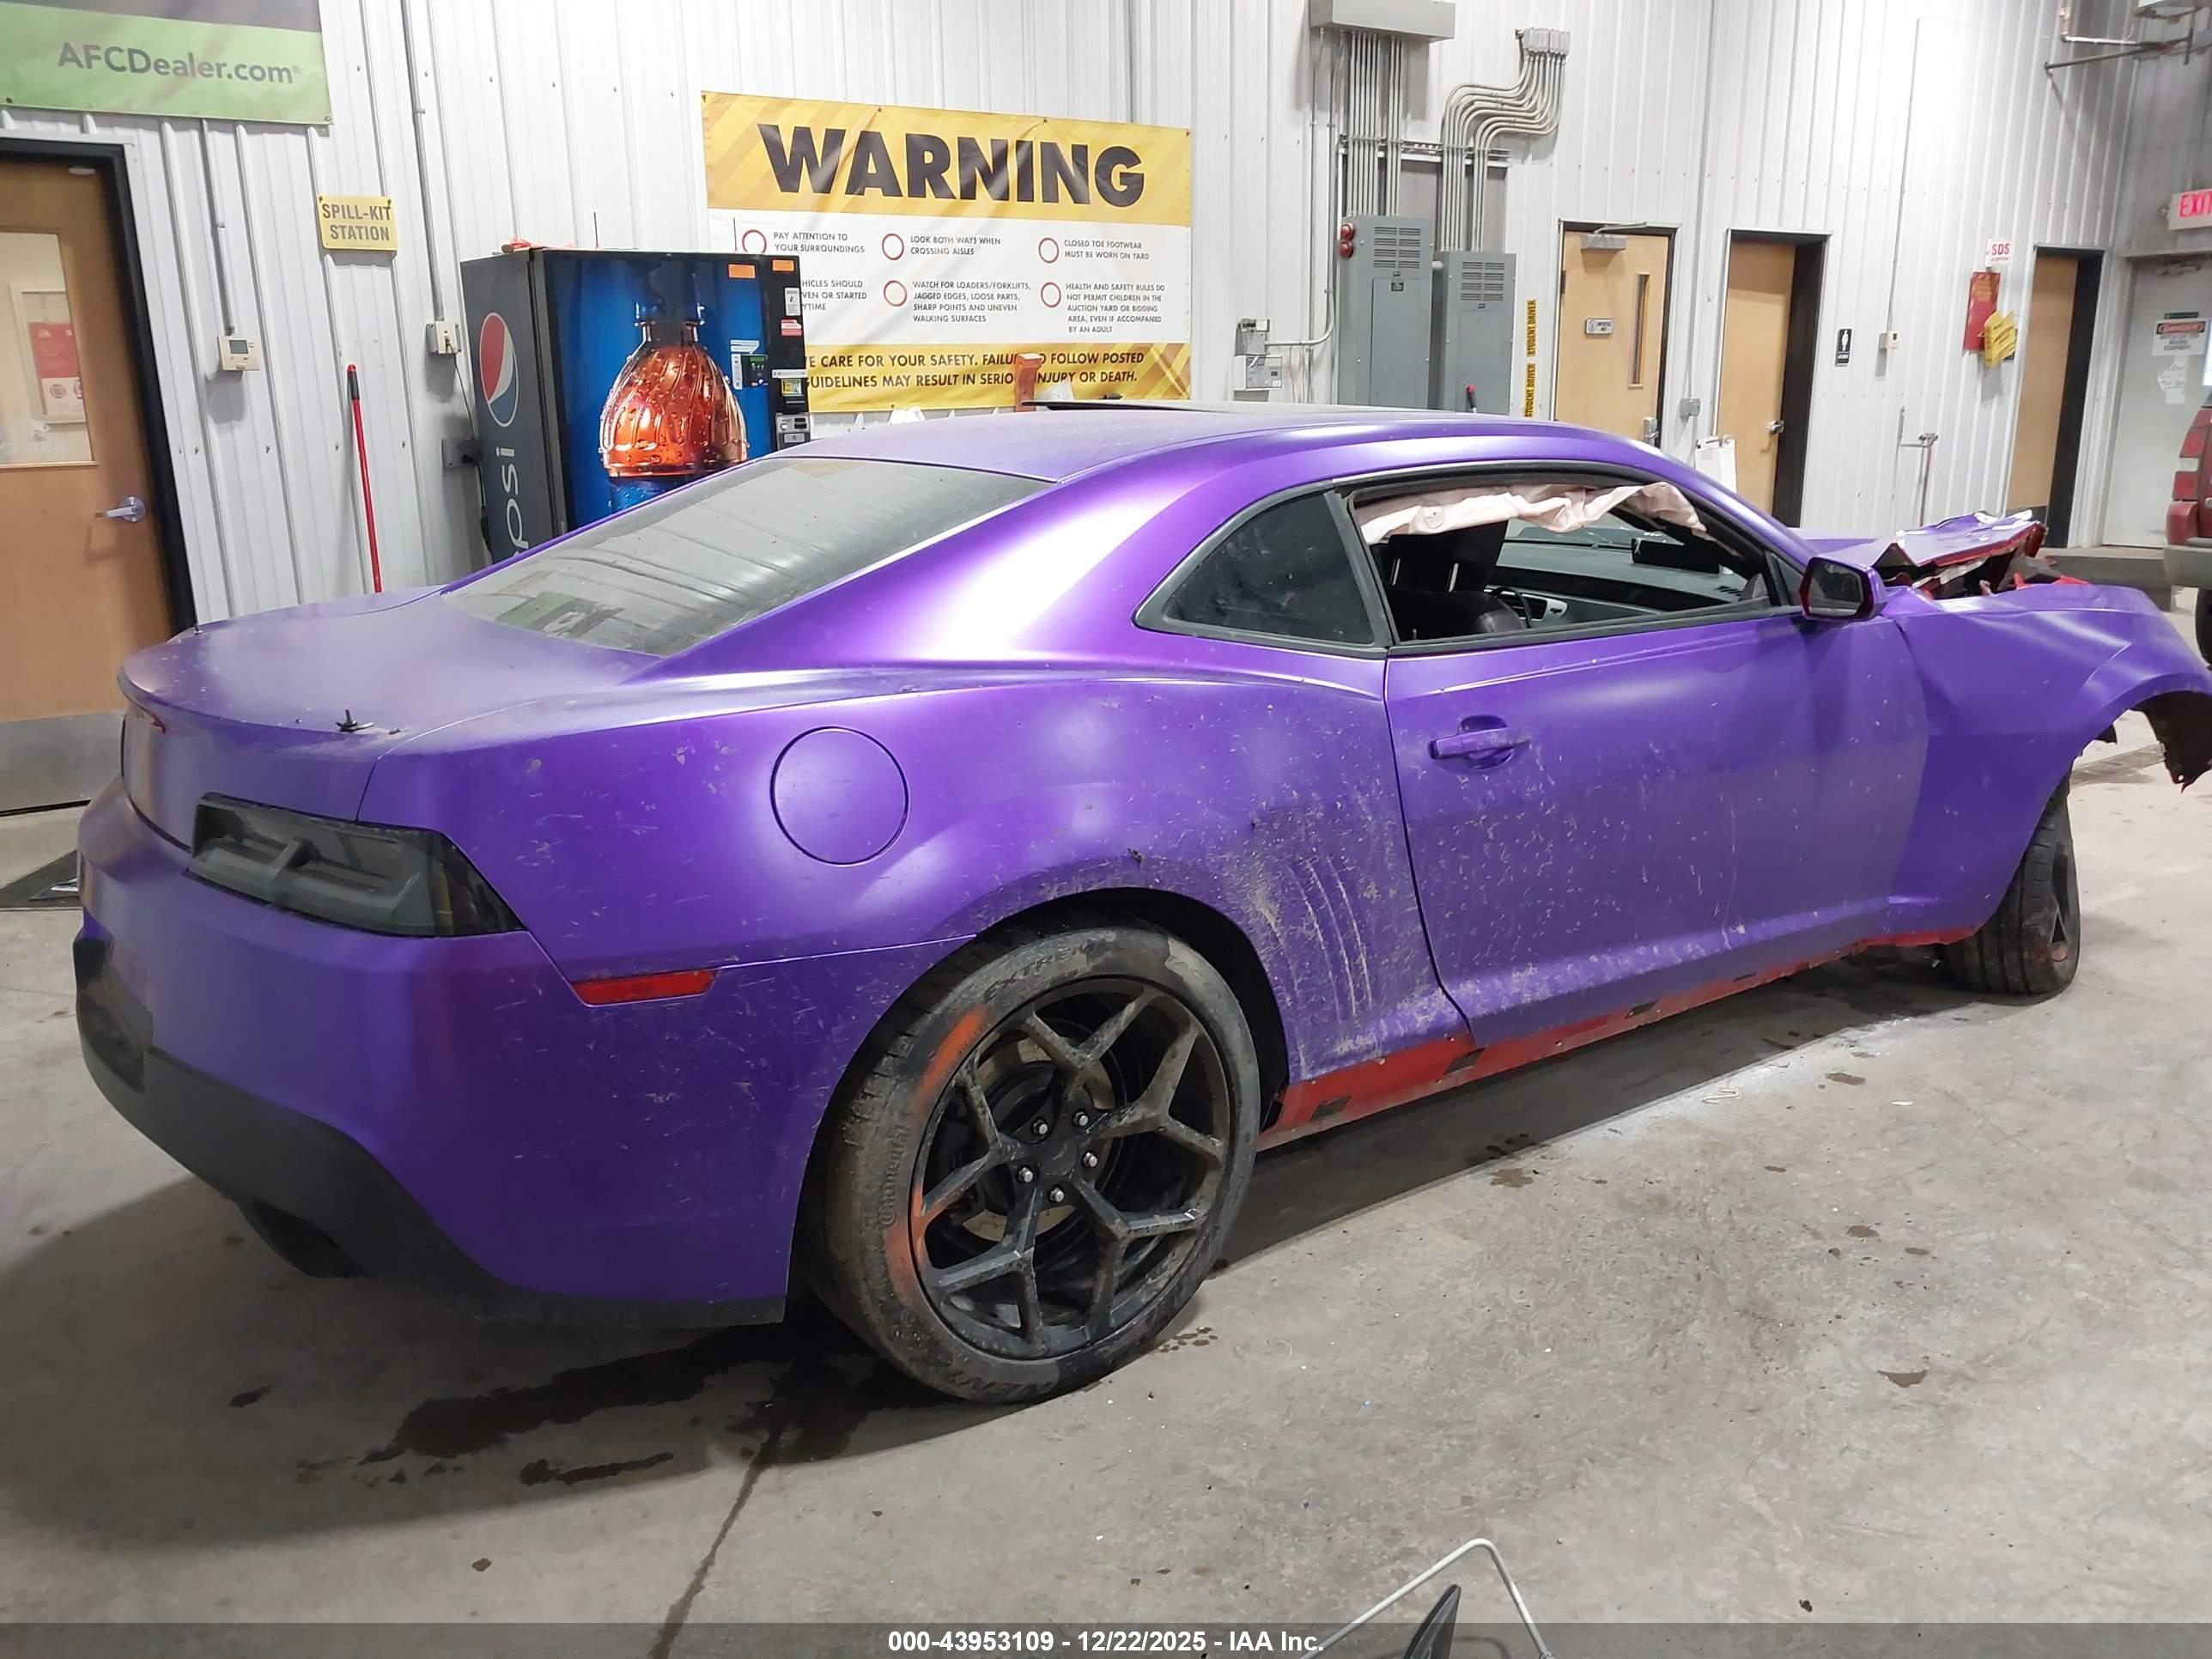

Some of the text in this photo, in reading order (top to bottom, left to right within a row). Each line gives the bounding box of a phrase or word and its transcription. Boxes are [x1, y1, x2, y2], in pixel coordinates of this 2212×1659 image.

[757, 123, 1145, 208] WARNING
[322, 204, 392, 221] SPILL-KIT
[330, 224, 390, 241] STATION
[774, 232, 789, 240] PAY
[837, 233, 848, 241] TO
[956, 236, 977, 245] WAYS
[1107, 240, 1142, 249] FOOTWEAR
[775, 244, 866, 253] YOUR SURROUNDINGS
[1992, 242, 2010, 256] SDS
[802, 279, 829, 288] HICLES
[957, 282, 1031, 290] LOADERS/FORKLIFTS,
[944, 293, 969, 301] EDGES,
[996, 293, 1021, 301] PARTS,
[914, 314, 949, 323] WALKING
[1067, 315, 1088, 324] AREA,
[805, 352, 1145, 368] E CARE FOR YOUR SAFETY. FAILU O FOLLOW POSTED
[883, 375, 911, 387] MAY
[916, 374, 959, 387] RESULT
[962, 374, 976, 386] IN
[980, 372, 1014, 385] SERIO
[1079, 372, 1097, 383] OR
[1100, 371, 1138, 383] DEATH.
[496, 446, 529, 554] psi
